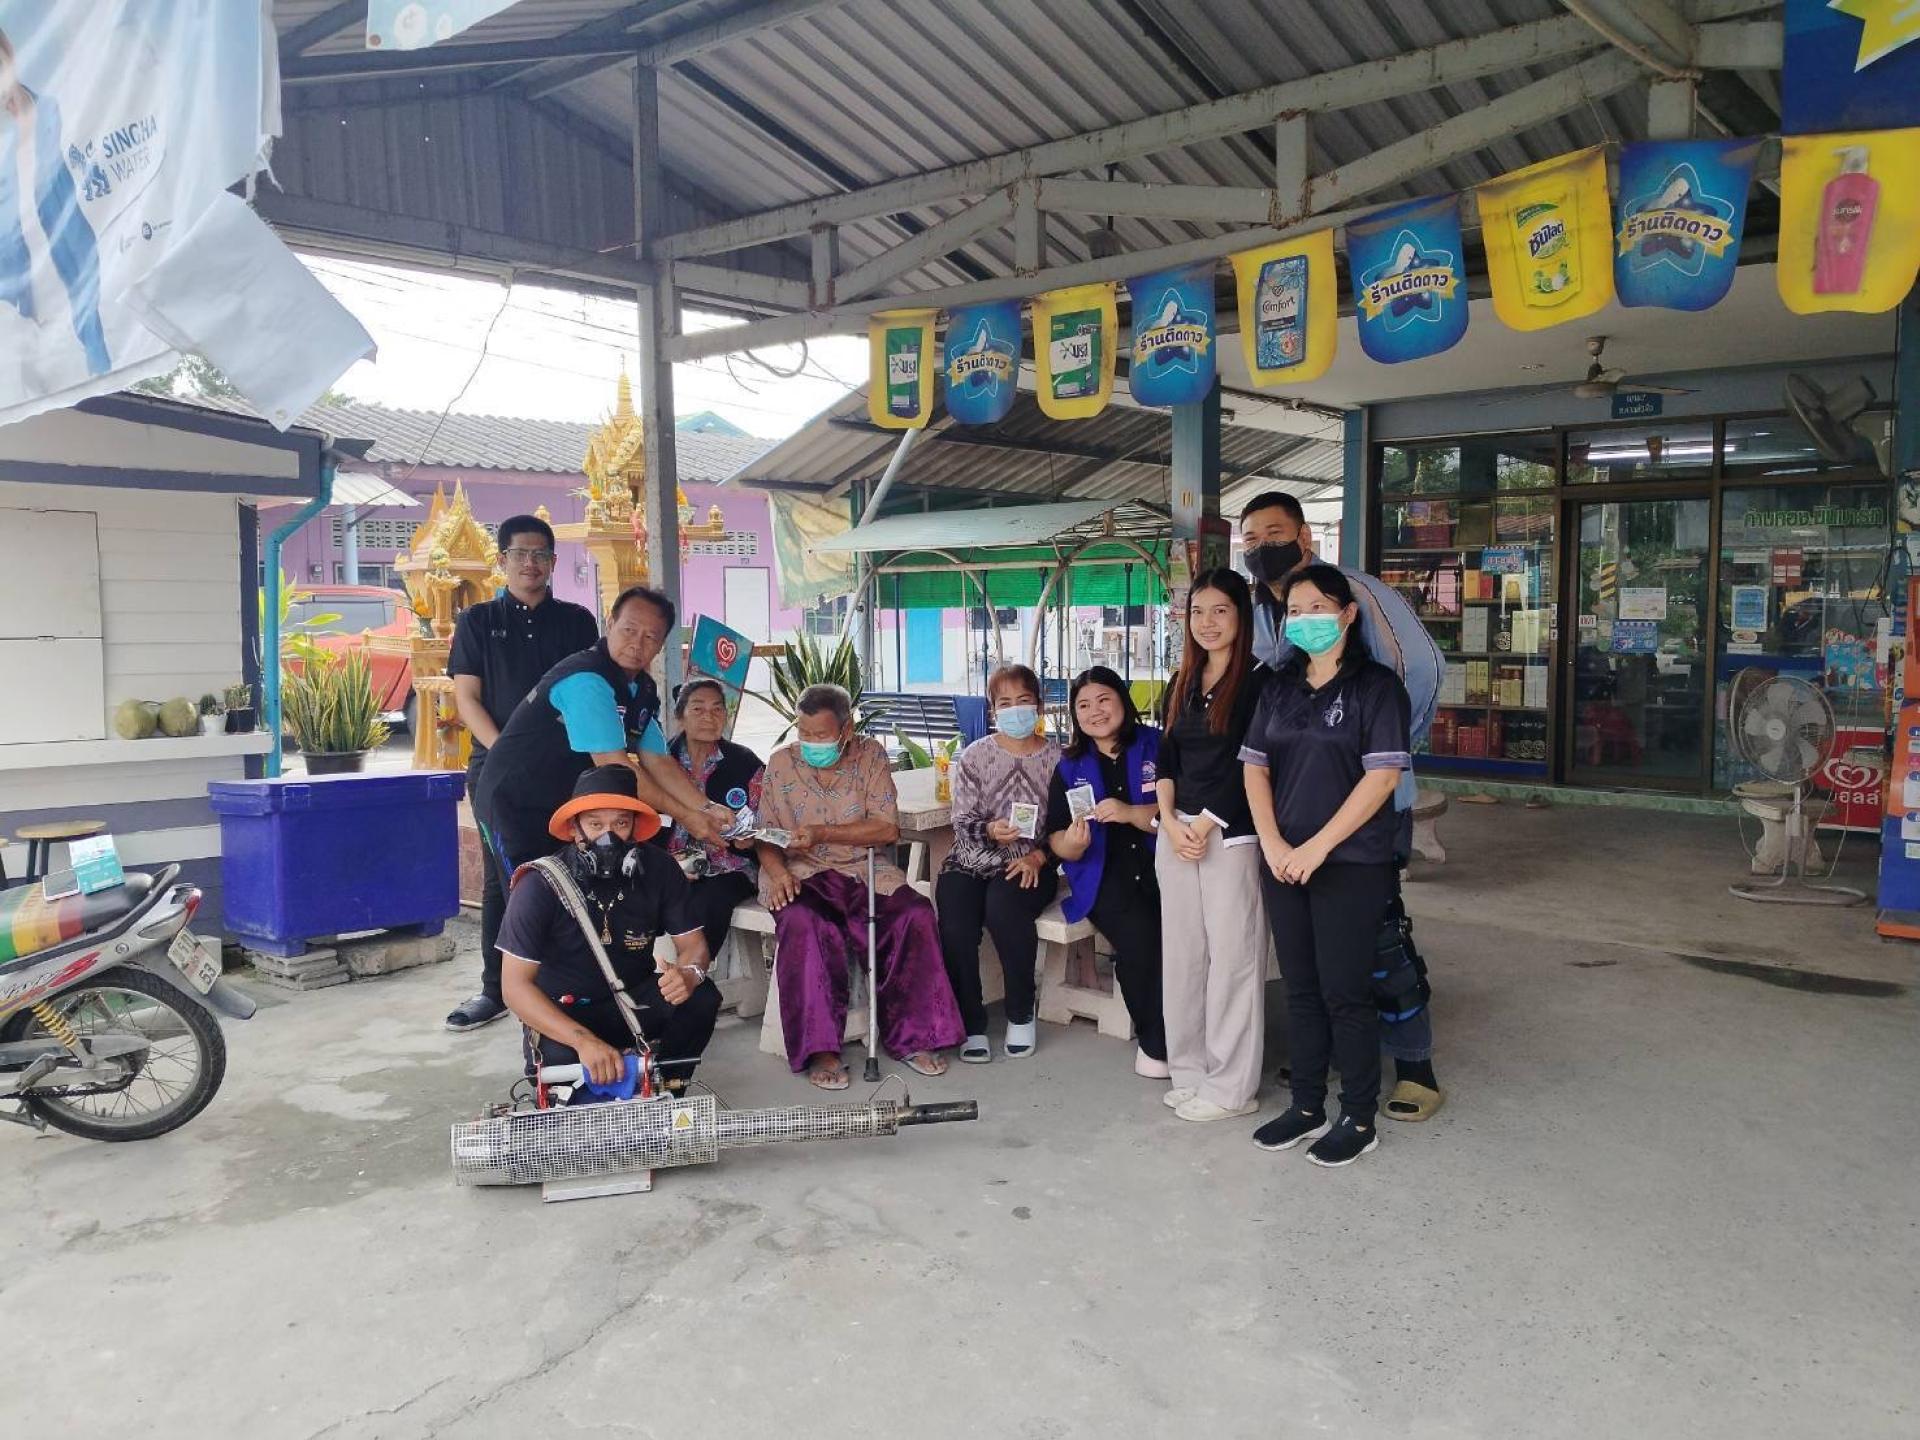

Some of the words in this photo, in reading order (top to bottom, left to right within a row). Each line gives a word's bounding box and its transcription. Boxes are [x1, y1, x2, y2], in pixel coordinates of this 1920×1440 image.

[103, 114, 157, 158] SINGHA
[1628, 211, 1723, 240] ร้านติดดาว
[1371, 273, 1448, 303] ร้านติดดาว
[1262, 296, 1296, 313] Comfort
[1141, 328, 1203, 351] ร้านติดดาว
